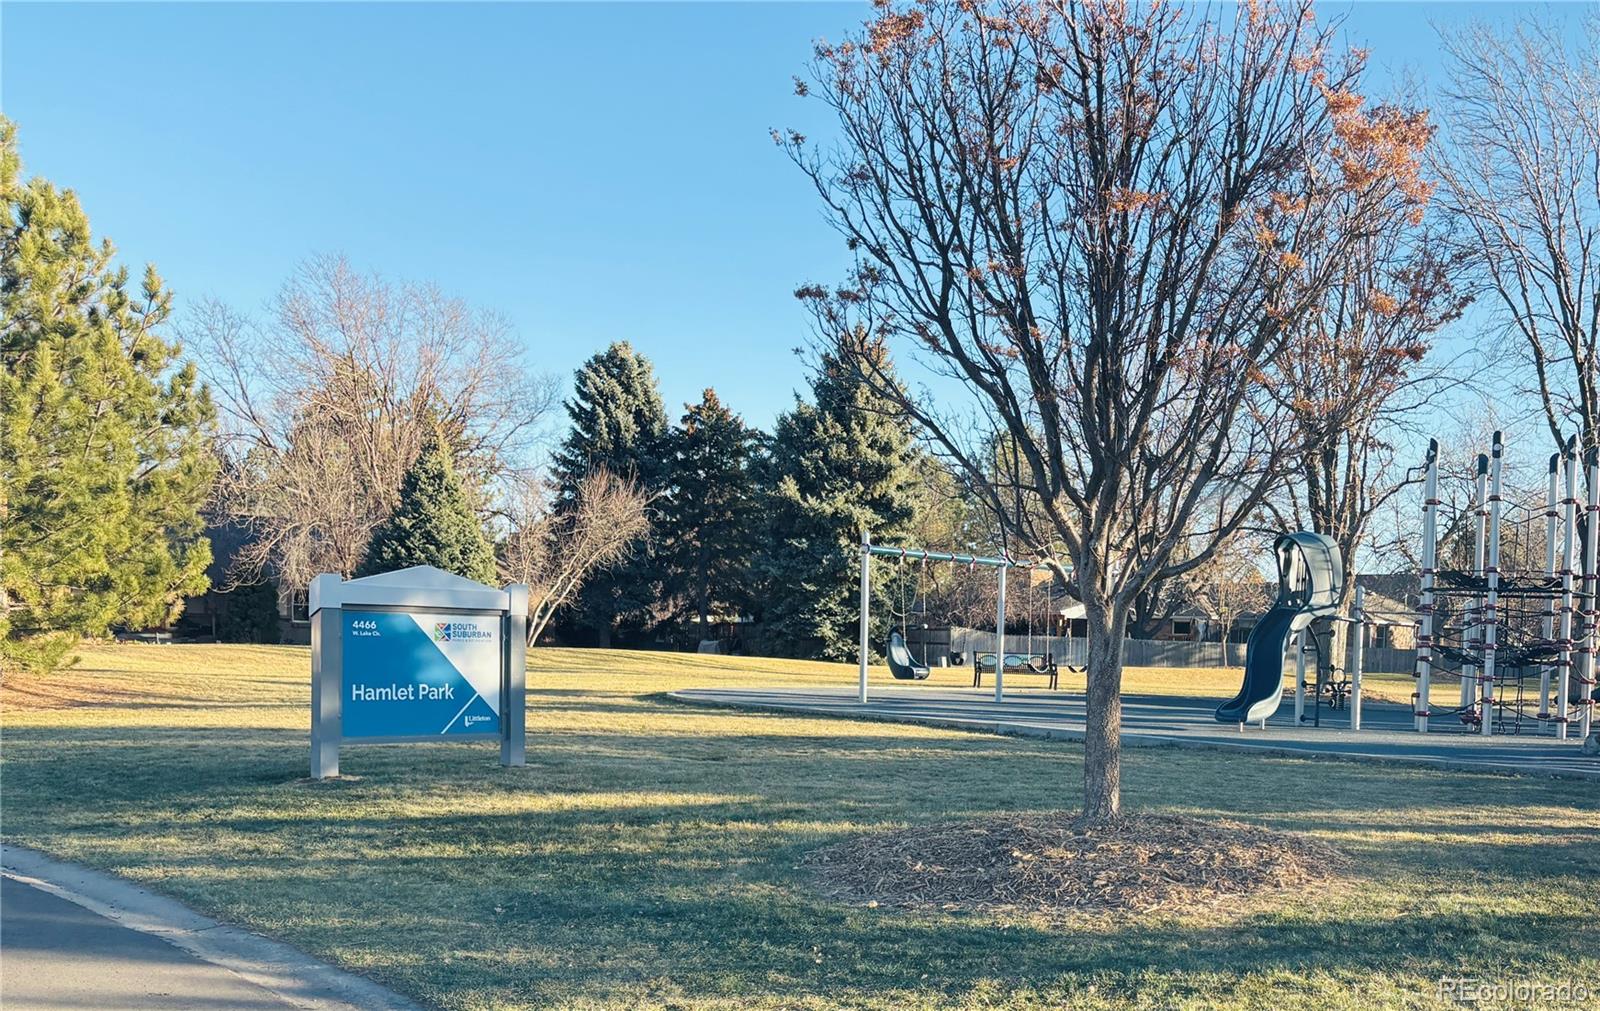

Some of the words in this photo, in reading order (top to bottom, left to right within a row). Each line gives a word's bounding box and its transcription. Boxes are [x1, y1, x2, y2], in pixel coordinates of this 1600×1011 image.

[352, 620, 377, 629] 4466
[452, 623, 477, 631] SOUTH
[452, 631, 492, 639] SUBURBAN
[352, 683, 414, 701] Hamlet
[419, 683, 454, 700] Park
